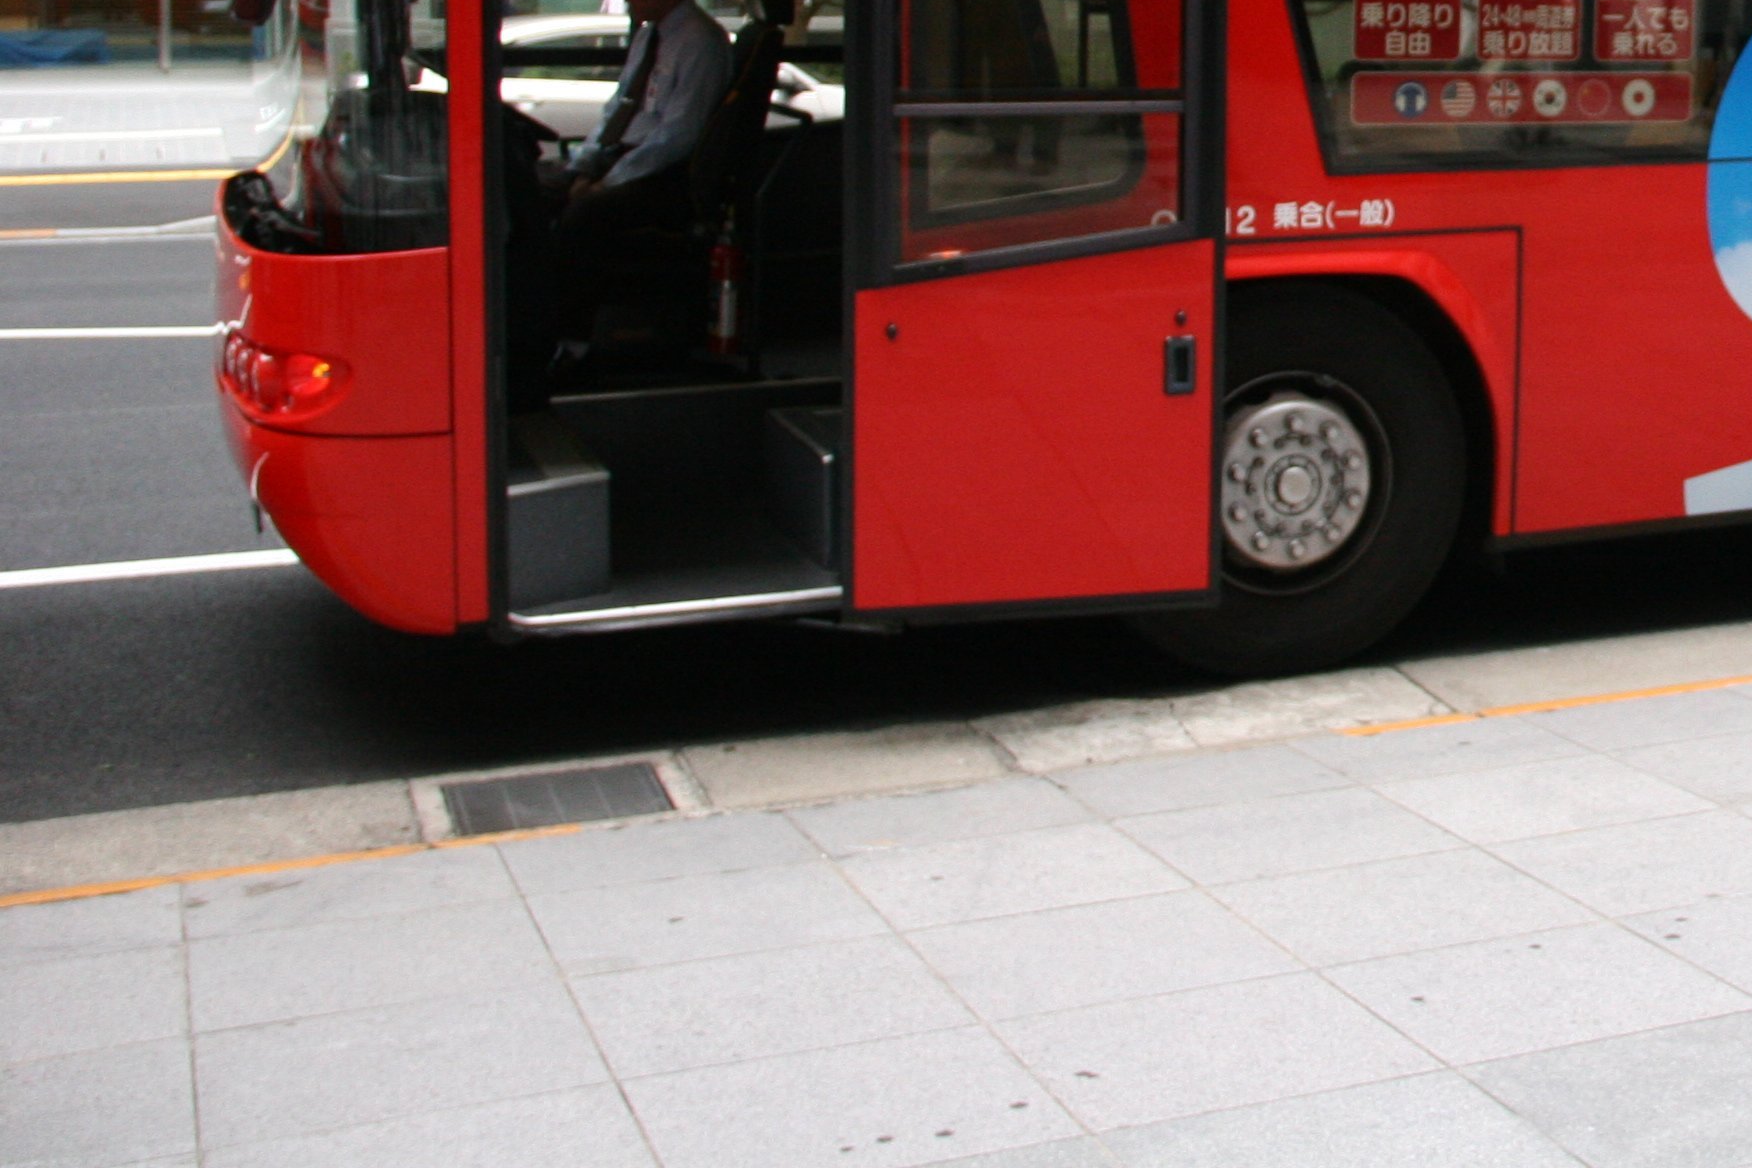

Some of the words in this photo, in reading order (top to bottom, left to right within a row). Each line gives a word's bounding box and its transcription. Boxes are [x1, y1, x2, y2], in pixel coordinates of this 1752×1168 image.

[1359, 1, 1454, 29] 乗り降り
[1384, 31, 1432, 57] 自由
[1612, 32, 1678, 56] 乗れる
